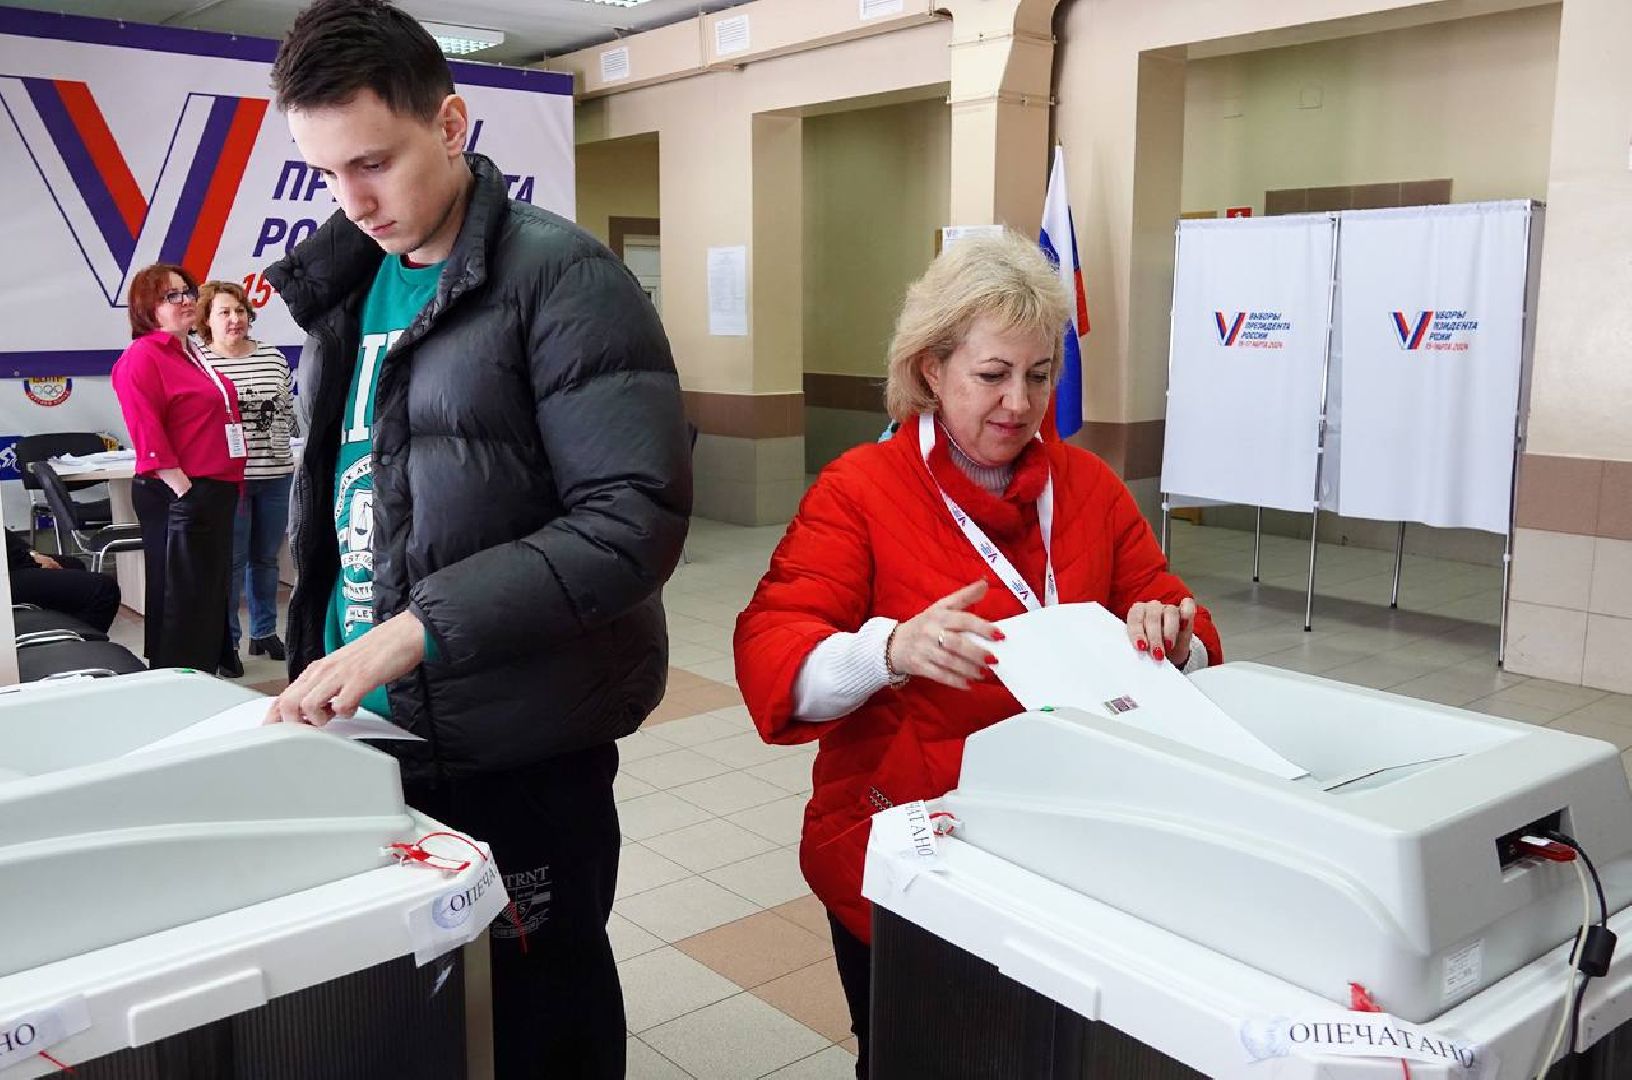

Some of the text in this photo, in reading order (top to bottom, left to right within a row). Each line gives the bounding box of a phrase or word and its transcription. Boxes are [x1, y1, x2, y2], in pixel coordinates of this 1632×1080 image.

[450, 864, 499, 911] ОПЕЧА
[502, 864, 550, 888] TRNT
[1288, 1021, 1475, 1069] ОПЕЧАТАНО
